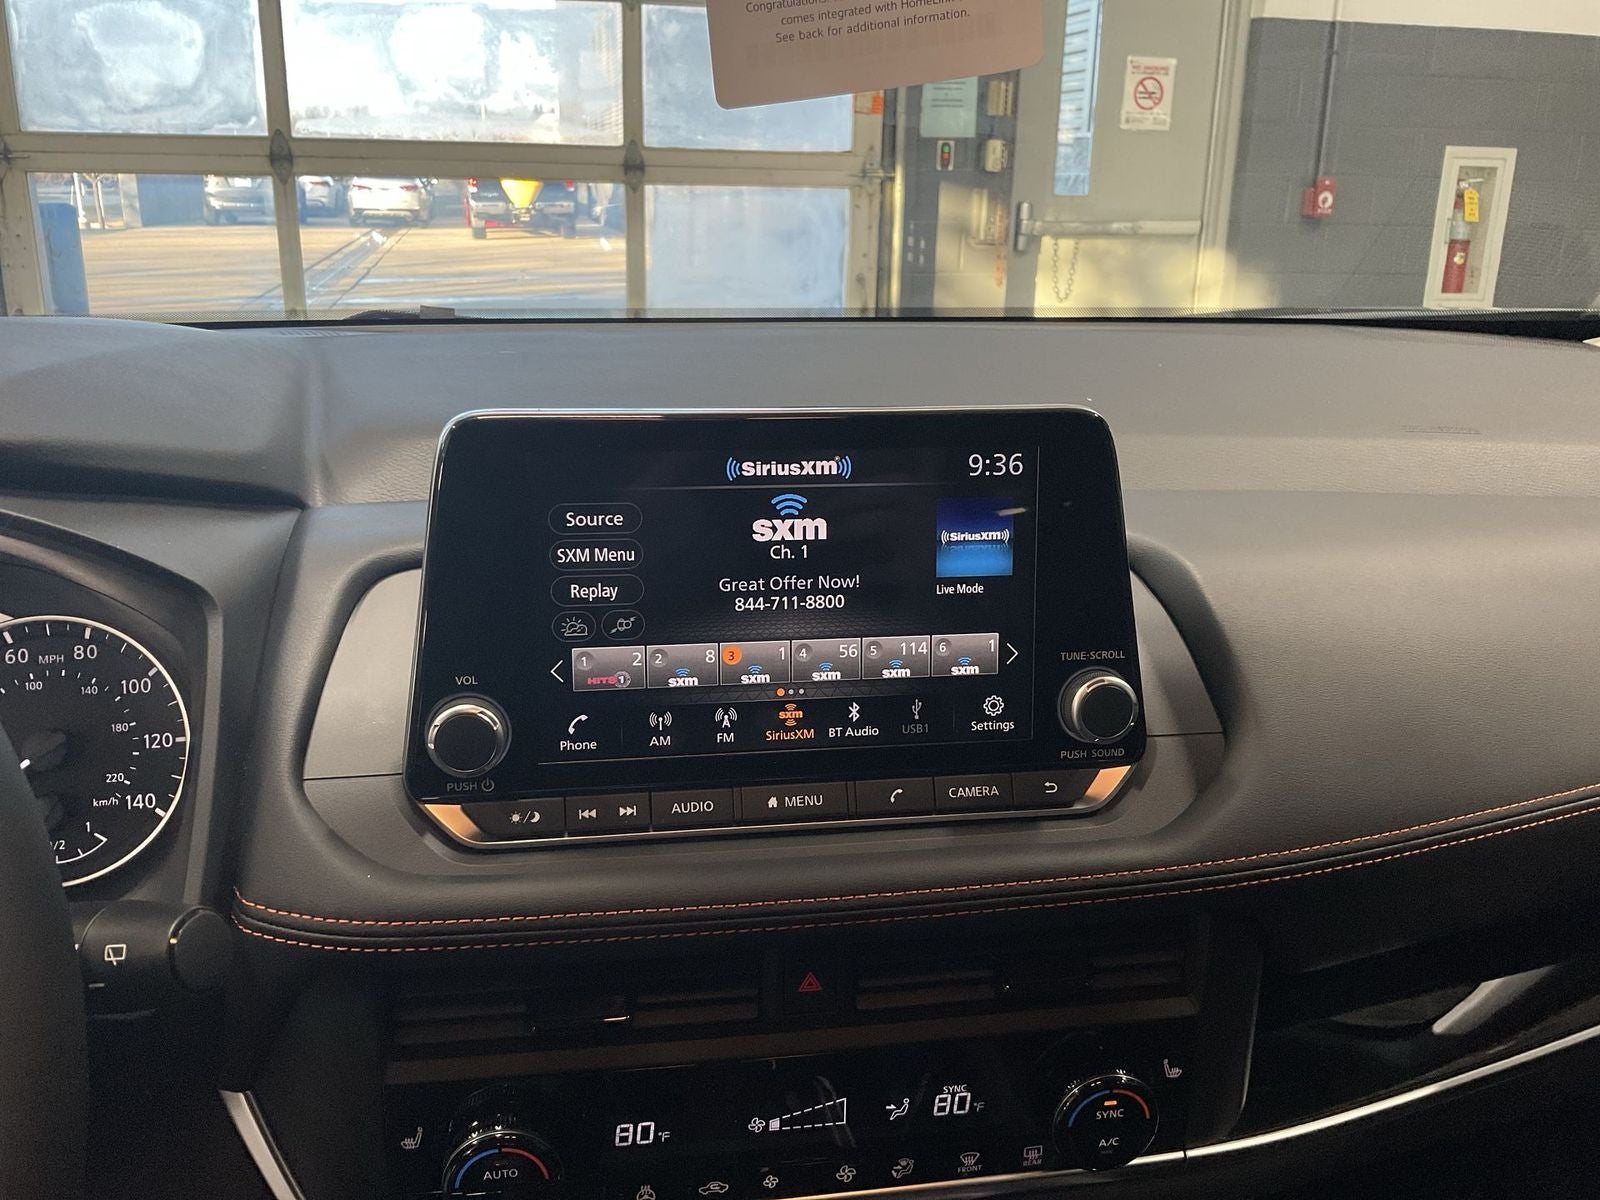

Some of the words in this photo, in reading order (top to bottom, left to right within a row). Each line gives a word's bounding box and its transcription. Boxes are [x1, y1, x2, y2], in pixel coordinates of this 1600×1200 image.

[781, 13, 814, 25] comes
[818, 4, 871, 21] integrated
[875, 2, 897, 13] with
[901, 0, 953, 9] Home
[775, 33, 795, 43] See
[799, 29, 823, 40] back
[827, 26, 843, 36] for
[847, 17, 900, 34] additional
[904, 9, 970, 26] information.
[968, 453, 1024, 476] 9:36
[566, 512, 624, 527] Source
[557, 548, 590, 563] SXM
[594, 547, 635, 562] Menu
[770, 545, 795, 559] Ch.
[801, 545, 808, 558] 1
[719, 578, 765, 592] Great
[769, 575, 813, 590] Offer
[818, 574, 860, 589] Now!
[936, 584, 955, 595] Live
[956, 583, 984, 594] Mode
[570, 583, 618, 601] Replay
[734, 594, 845, 611] 844-711-8800
[839, 644, 858, 658] 56
[870, 646, 877, 655] 5
[900, 641, 928, 656] 114
[939, 643, 947, 652] 6
[988, 639, 994, 652] 1
[5, 649, 29, 664] 60
[73, 645, 97, 660] 80
[655, 653, 662, 664] 2
[705, 649, 715, 663] 8
[728, 651, 735, 661] 3
[778, 647, 785, 660] 1
[799, 648, 807, 658] 4
[38, 654, 64, 665] MPH
[581, 656, 587, 667] 1
[632, 652, 642, 666] 2
[25, 681, 43, 691] 100
[455, 675, 478, 685] VOL
[81, 685, 98, 695] 140
[121, 678, 151, 695] 100
[111, 722, 129, 732] 180
[828, 727, 842, 738] BT
[845, 726, 879, 737] Audio
[902, 724, 929, 734] USB1
[971, 721, 1015, 733] Settings
[143, 733, 173, 748] 120
[717, 732, 734, 743] FM
[766, 729, 815, 741] SiriusXM
[560, 740, 597, 751] Phone
[649, 736, 671, 747] AM
[1060, 750, 1087, 759] PUSH
[1091, 748, 1125, 758] SOUND
[106, 773, 124, 783] 220
[446, 782, 478, 792] PUSH
[949, 785, 999, 798] CAMERA
[93, 797, 119, 807] km/h
[126, 793, 156, 810] 140
[785, 795, 823, 807] MENU
[671, 801, 714, 814] AUDIO
[86, 821, 90, 832] 1
[943, 1084, 967, 1094] SYNC
[933, 1092, 971, 1116] 80
[1096, 1109, 1124, 1120] SYNC
[615, 1121, 655, 1147] 80
[1098, 1137, 1120, 1148] A/C
[1023, 1157, 1042, 1166] REAR
[483, 1168, 518, 1181] AUTO
[957, 1165, 982, 1174] FRONT
